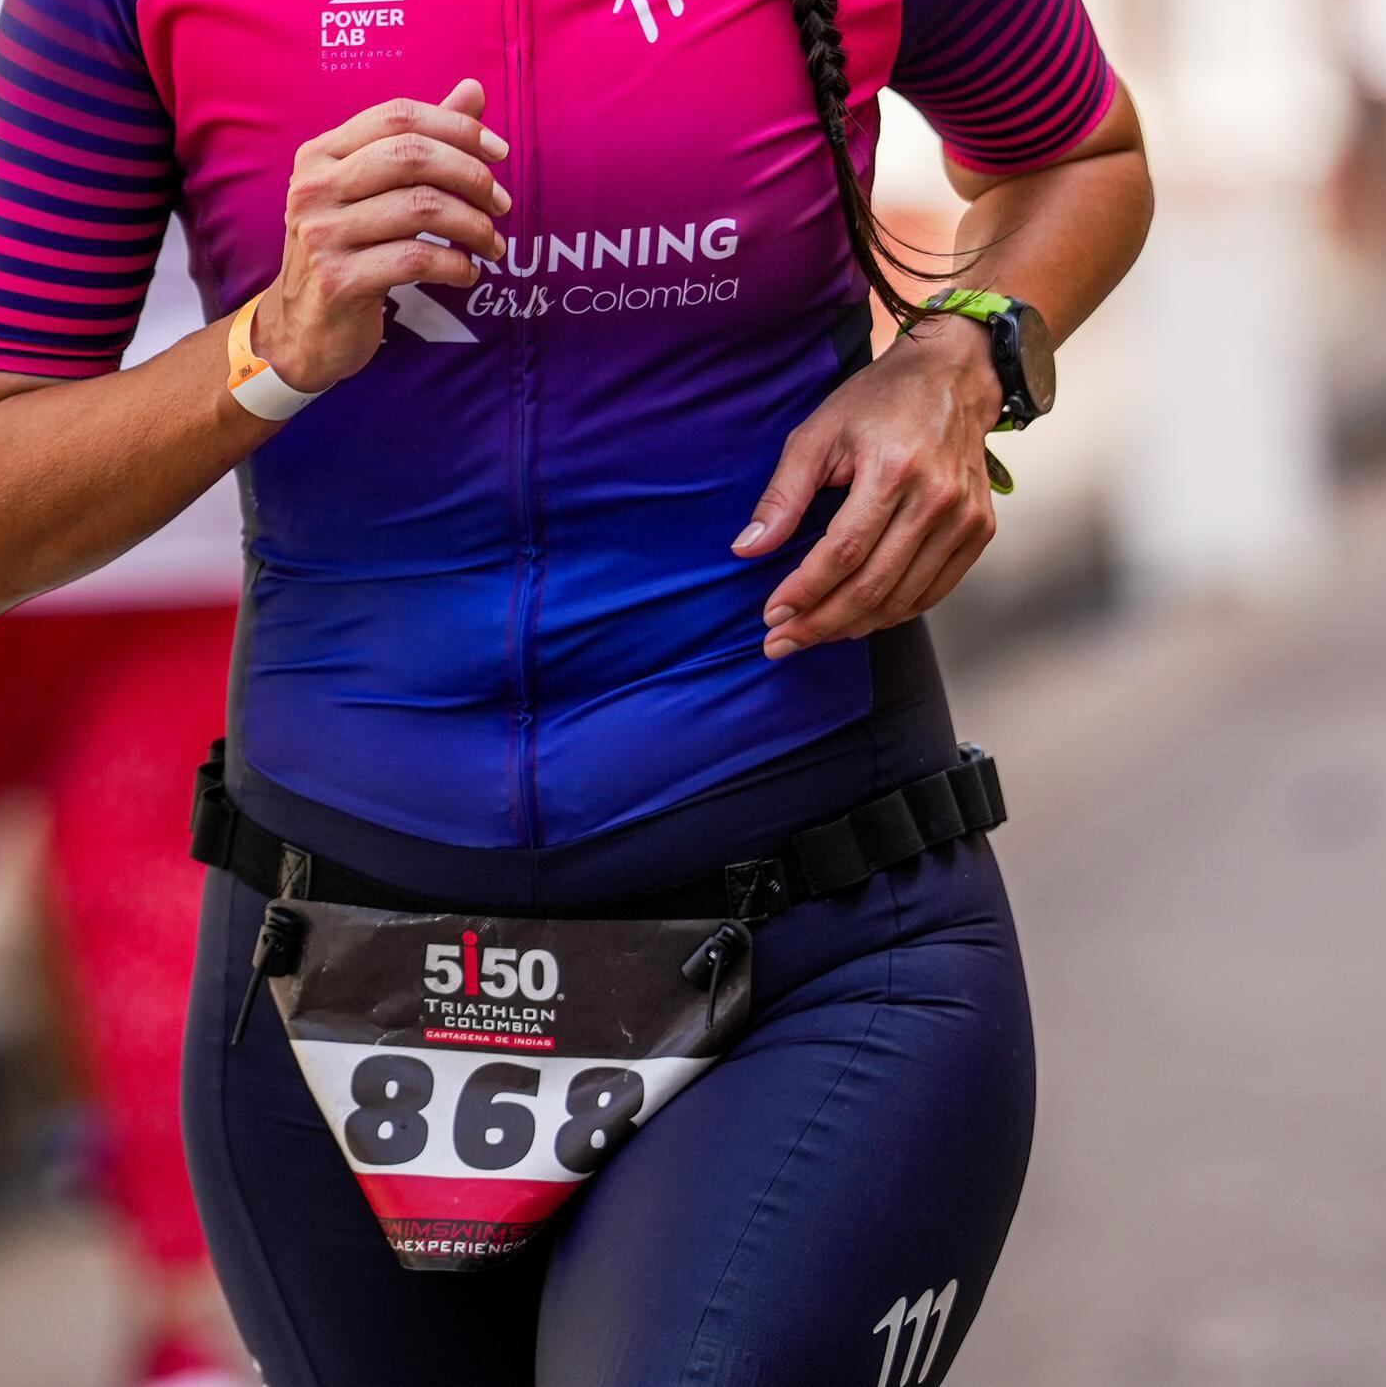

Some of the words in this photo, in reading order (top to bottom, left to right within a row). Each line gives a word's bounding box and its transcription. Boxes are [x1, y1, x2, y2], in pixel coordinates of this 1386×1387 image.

[321, 9, 405, 29] POWER
[321, 29, 366, 48] LAB
[321, 48, 404, 60] Endurance
[321, 61, 372, 73] Sports
[466, 282, 556, 320] Girls
[562, 273, 740, 315] Colombia
[423, 998, 556, 1022] TRIATHLON
[444, 1016, 543, 1034] COLOMBIA
[426, 1030, 490, 1043] CARTAGENA
[494, 1035, 510, 1044] DE
[513, 1036, 552, 1047] INDIAS
[343, 1053, 645, 1174] 868
